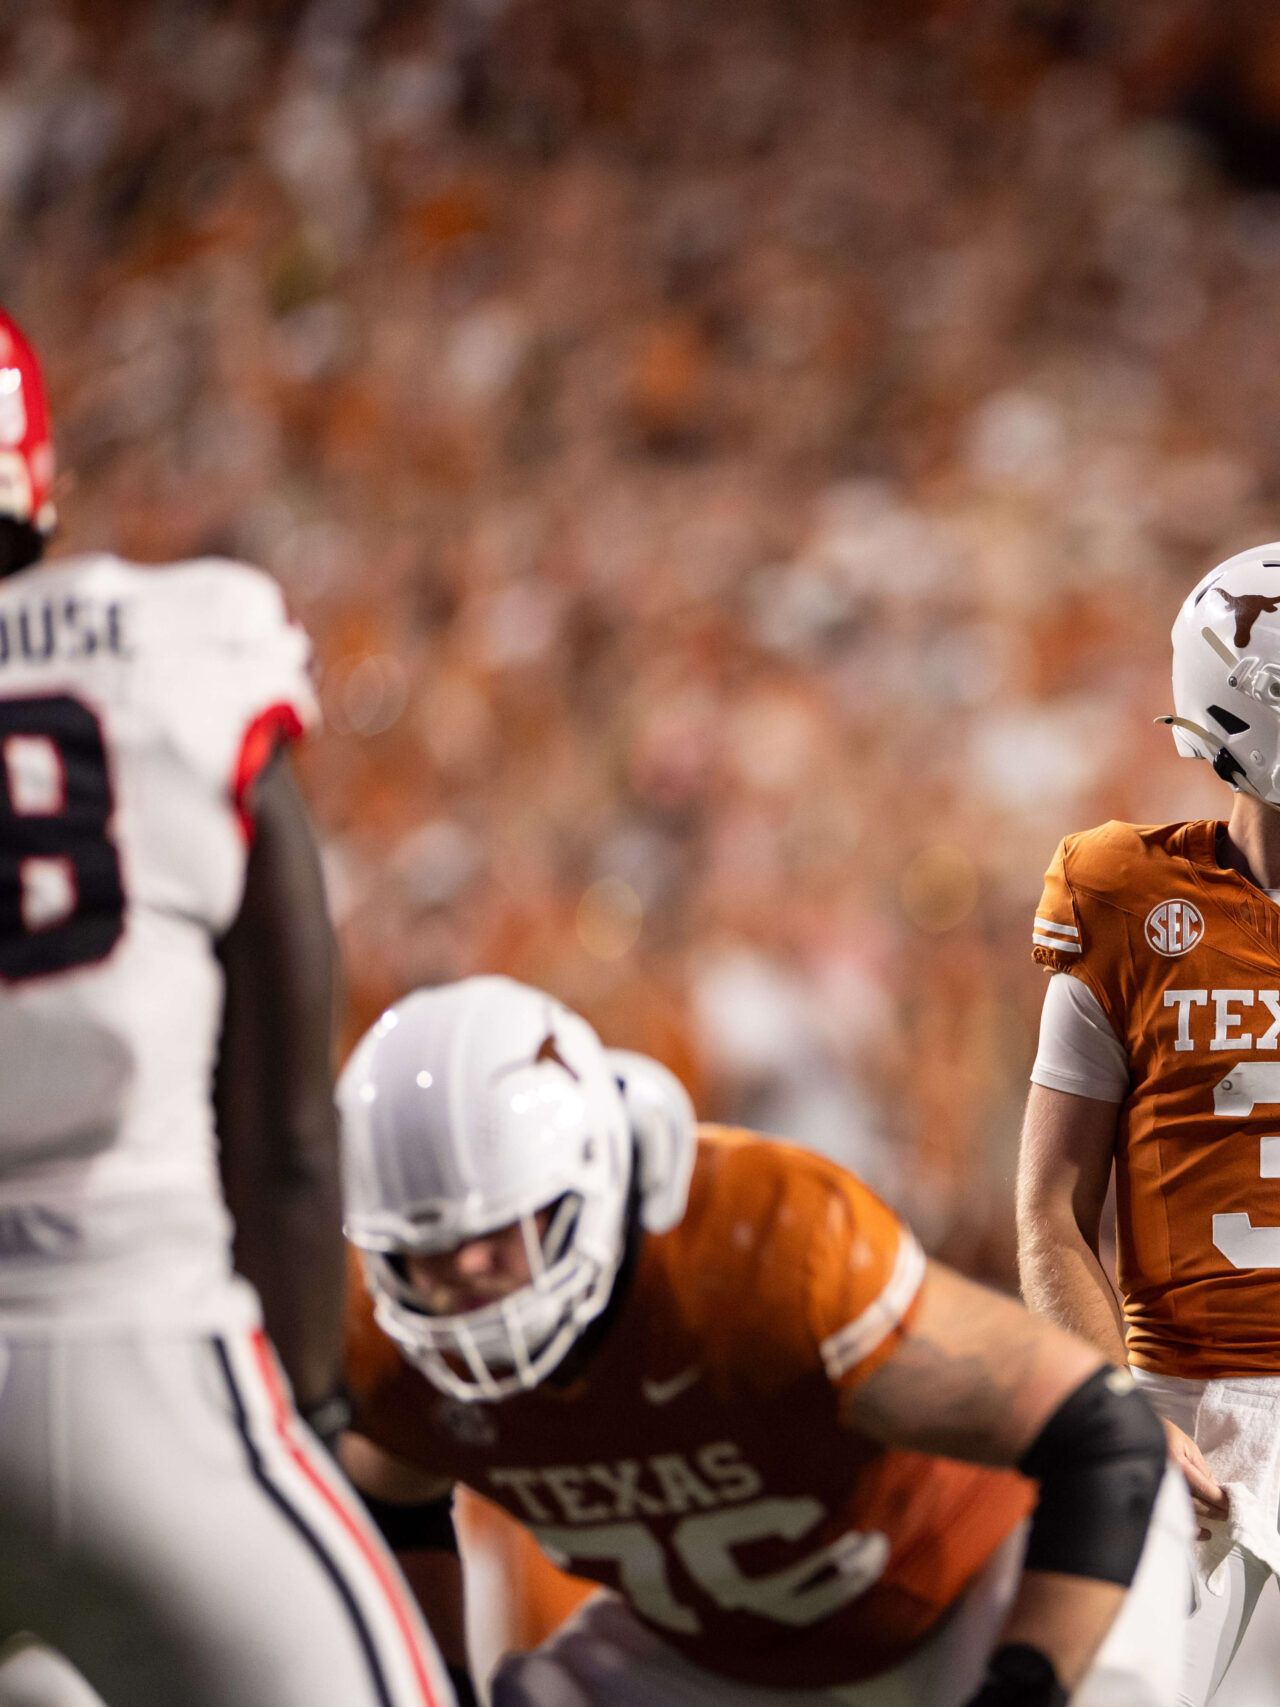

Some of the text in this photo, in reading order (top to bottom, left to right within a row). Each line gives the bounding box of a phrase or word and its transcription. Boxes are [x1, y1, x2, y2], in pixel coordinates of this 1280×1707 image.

[0, 598, 134, 662] USE
[1150, 903, 1199, 953] SEC
[488, 1442, 765, 1523] TEXAS
[534, 1494, 891, 1636] 76
